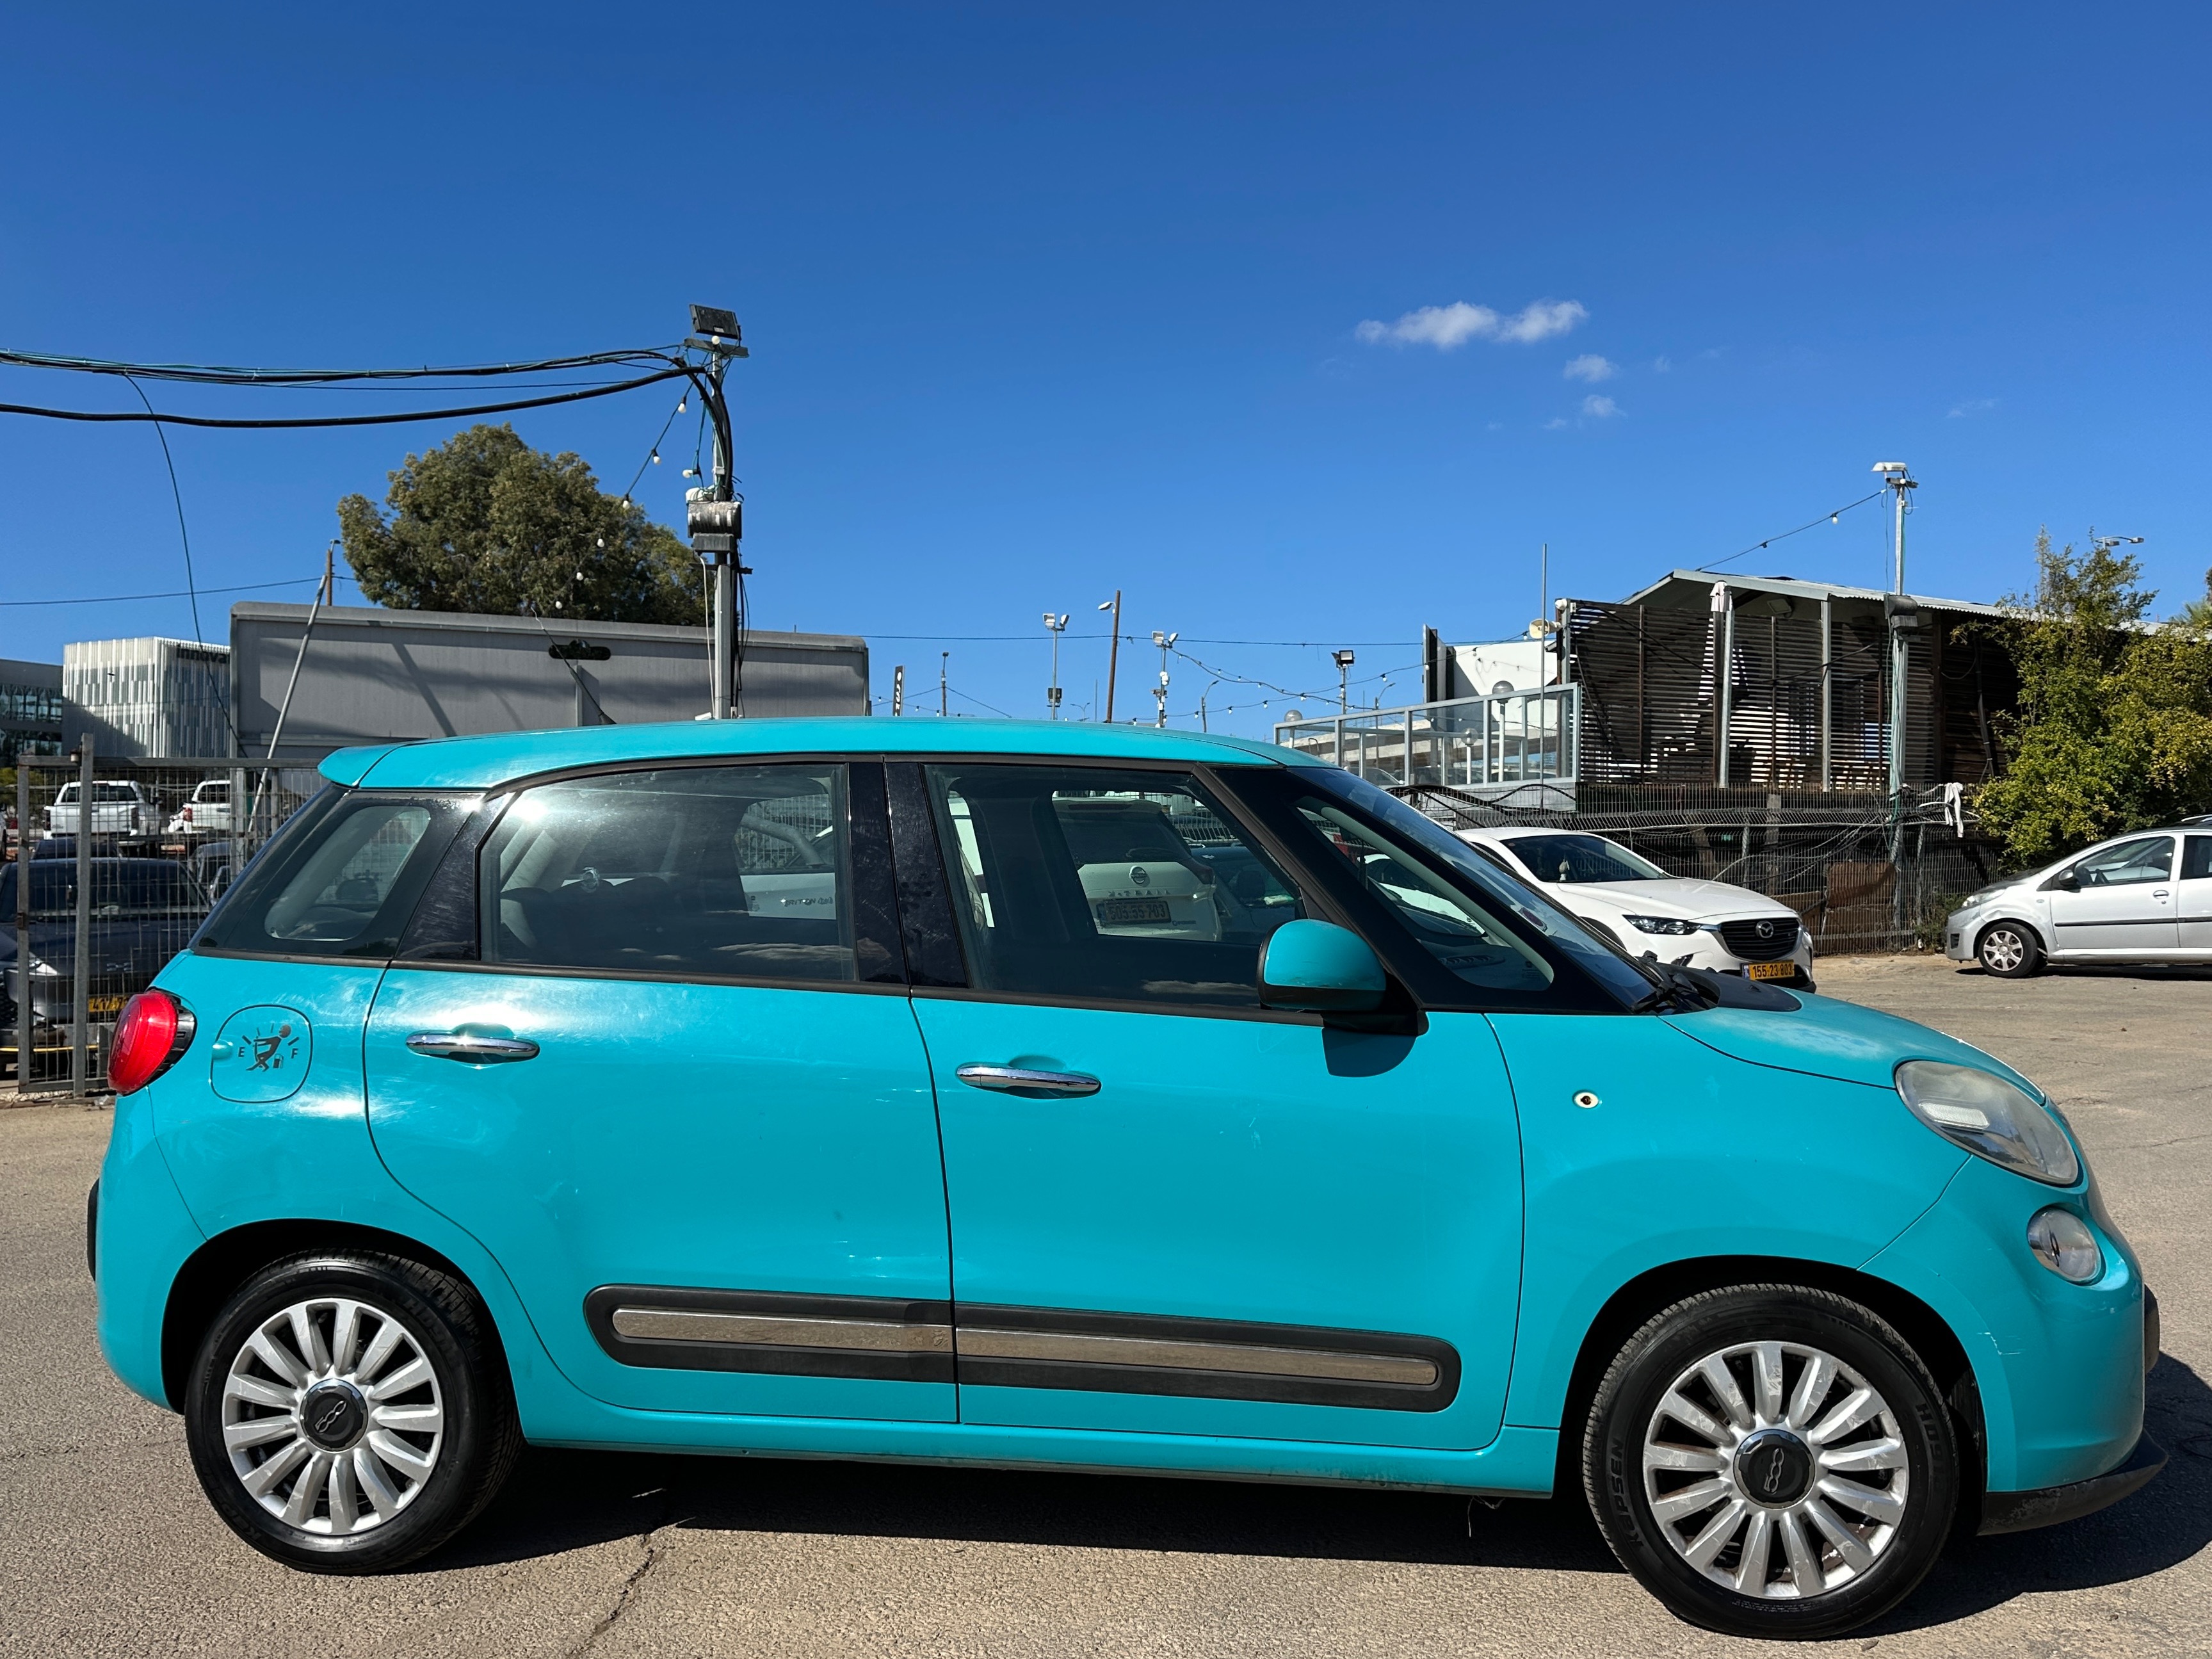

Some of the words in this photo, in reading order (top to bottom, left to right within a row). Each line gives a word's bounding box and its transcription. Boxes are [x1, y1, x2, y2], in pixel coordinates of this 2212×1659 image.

[177, 643, 230, 664] innova
[238, 1046, 245, 1057] E
[291, 1048, 298, 1058] F
